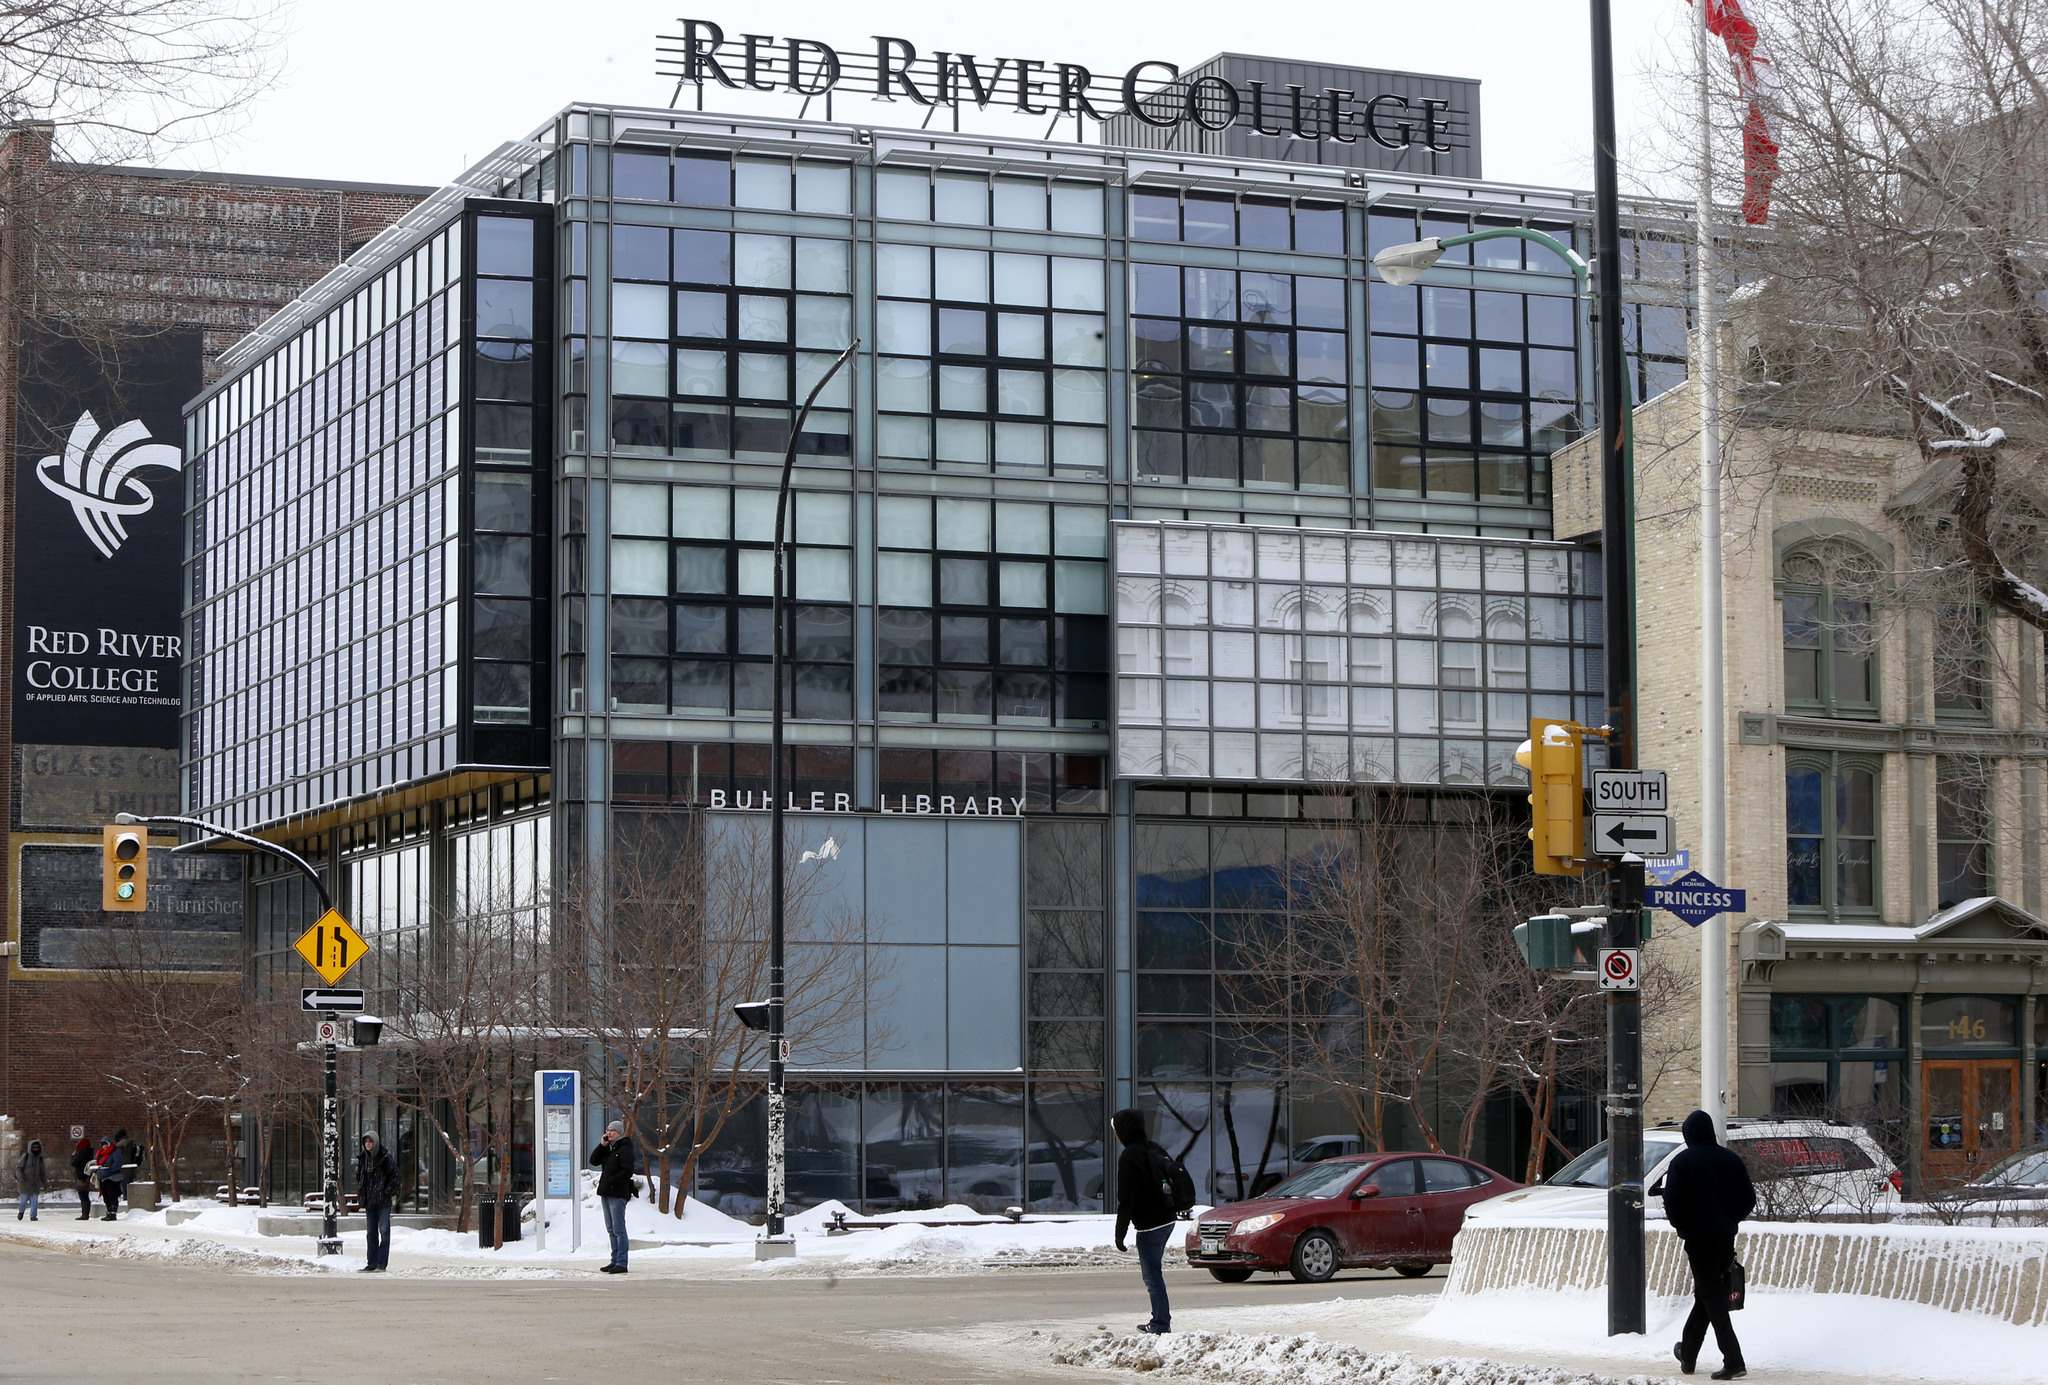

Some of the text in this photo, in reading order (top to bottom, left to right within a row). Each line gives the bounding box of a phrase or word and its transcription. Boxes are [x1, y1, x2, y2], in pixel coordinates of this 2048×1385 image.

[676, 18, 1451, 154] RED RIVER COLLEGE
[27, 625, 182, 658] RED RIVER
[26, 660, 159, 692] COLLEGE
[26, 693, 35, 701] OF
[36, 693, 66, 702] APPLIED
[90, 695, 121, 704] SCIENCE
[122, 697, 138, 705] AND
[139, 696, 181, 706] TECHNOLOG
[710, 788, 1025, 816] BUHLER LIBRARY
[1600, 781, 1660, 801] SOUTH
[1644, 854, 1684, 868] WILLIAM
[1654, 890, 1732, 907] PRINCESS
